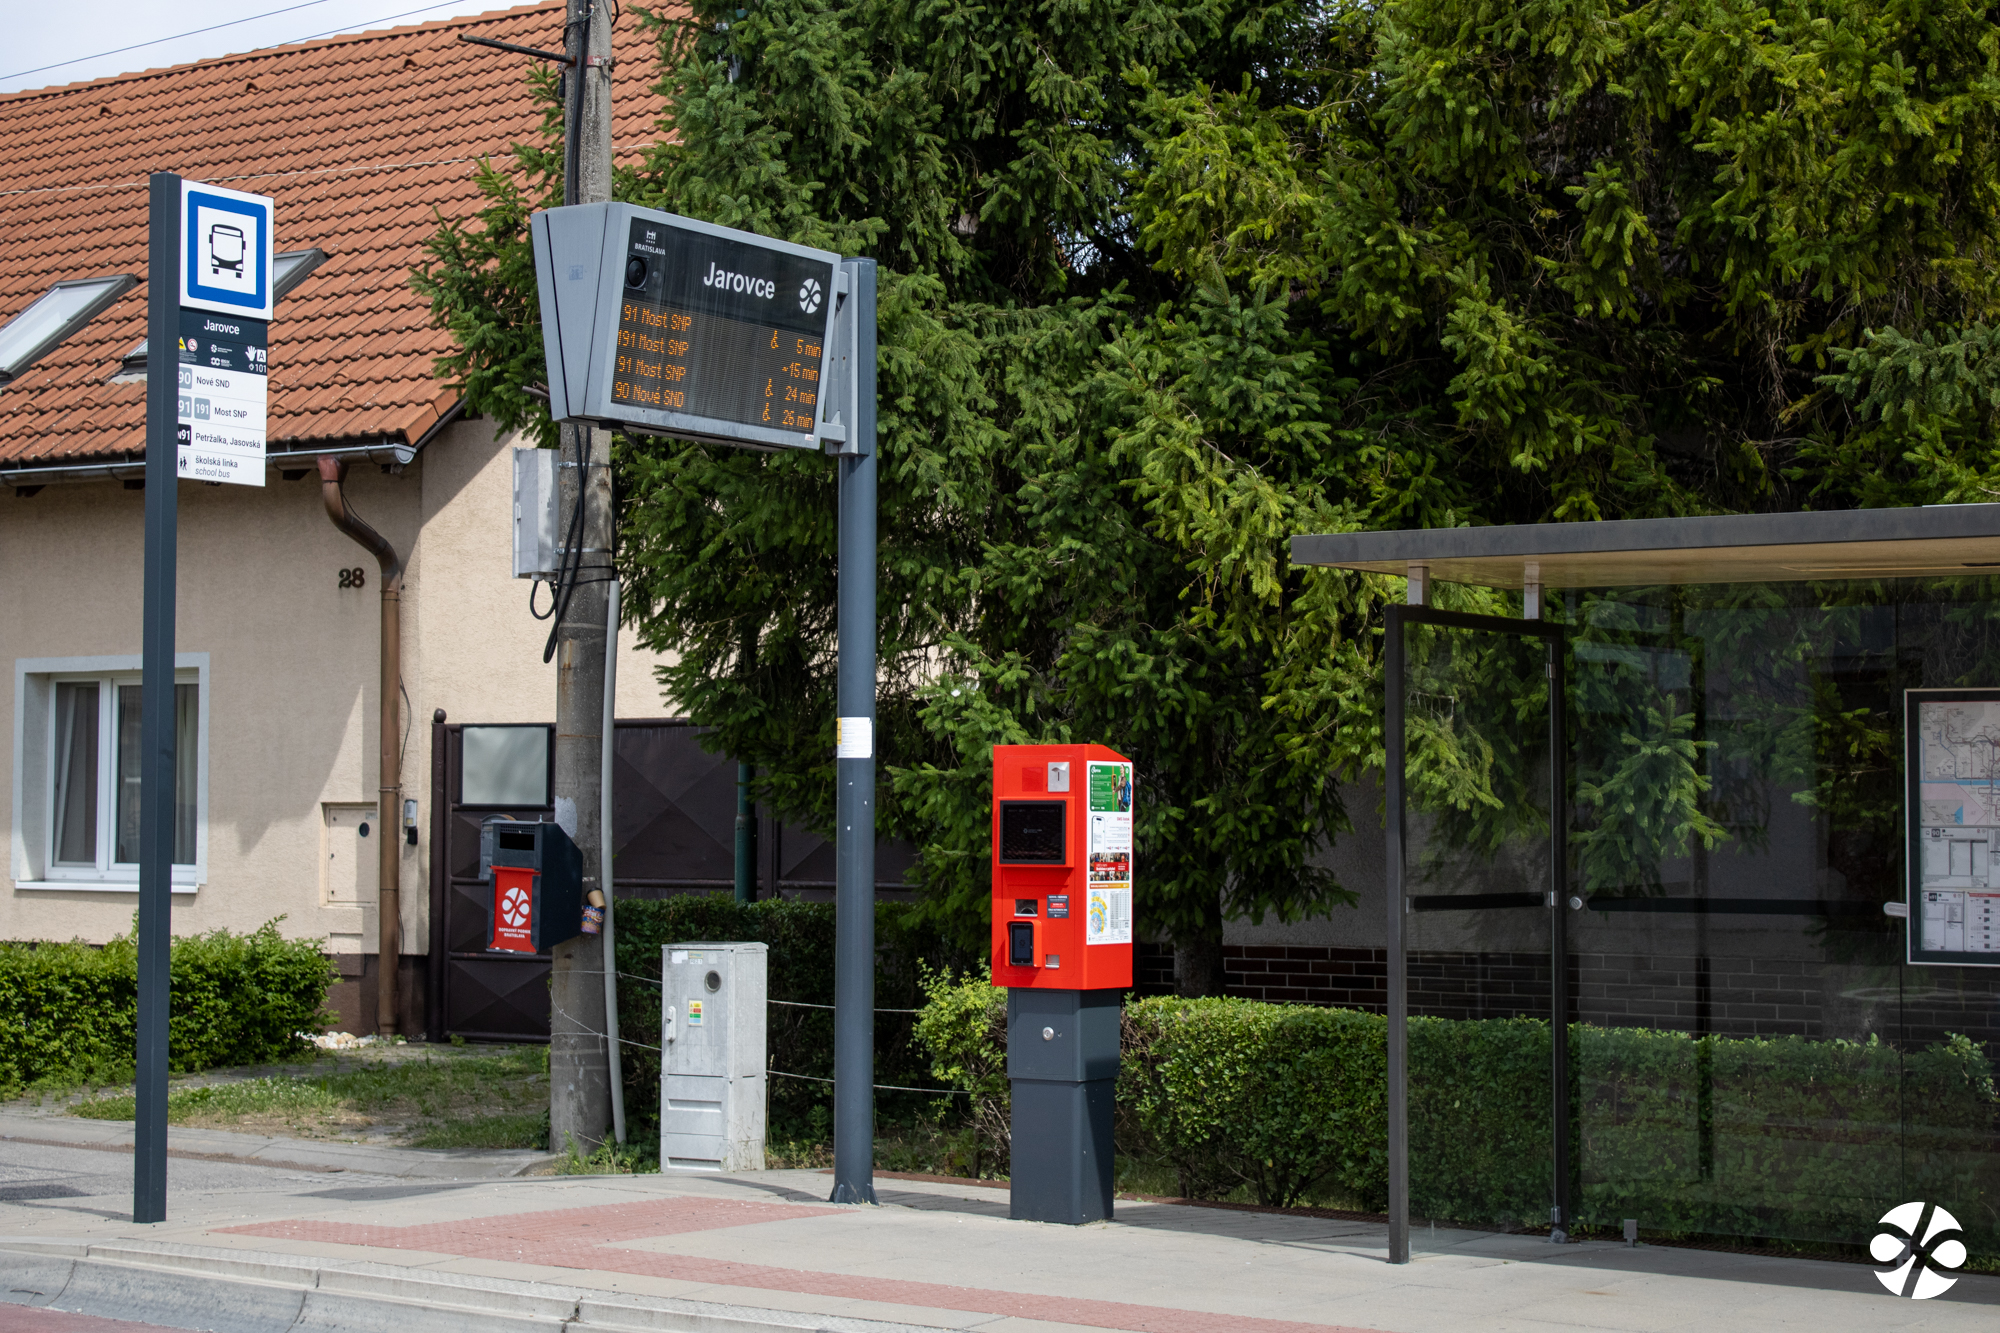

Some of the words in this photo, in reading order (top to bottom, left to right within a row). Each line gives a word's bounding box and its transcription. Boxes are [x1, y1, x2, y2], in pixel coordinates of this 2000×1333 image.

[634, 242, 666, 256] BRATISLAVA
[704, 262, 775, 300] Jarovce
[204, 319, 240, 335] Jarovce
[624, 304, 638, 322] 91
[642, 308, 668, 328] Most
[670, 314, 692, 332] SNP
[796, 338, 804, 354] 5
[804, 342, 822, 358] min
[618, 330, 636, 348] 191
[638, 333, 664, 353] Most
[668, 339, 689, 356] SNP
[802, 366, 818, 382] min
[254, 364, 266, 373] 101
[179, 371, 191, 385] 90
[196, 376, 214, 386] Nové
[216, 378, 230, 388] SND
[618, 356, 632, 373] 91
[636, 359, 662, 378] Most
[664, 364, 686, 382] SNP
[784, 386, 798, 402] 24
[800, 390, 816, 405] min
[178, 400, 190, 414] 91
[196, 404, 208, 414] 191
[214, 407, 232, 417] Most
[233, 410, 248, 418] SNP
[616, 382, 630, 398] 90
[633, 384, 660, 404] Nové
[664, 390, 684, 408] SND
[782, 410, 794, 426] 26
[797, 413, 814, 428] min
[196, 432, 228, 445] Petržalka,
[230, 438, 260, 448] Jasovská
[196, 456, 220, 466] školská
[222, 458, 238, 468] linka
[195, 468, 218, 477] school
[218, 470, 230, 478] bus
[338, 567, 365, 588] 28
